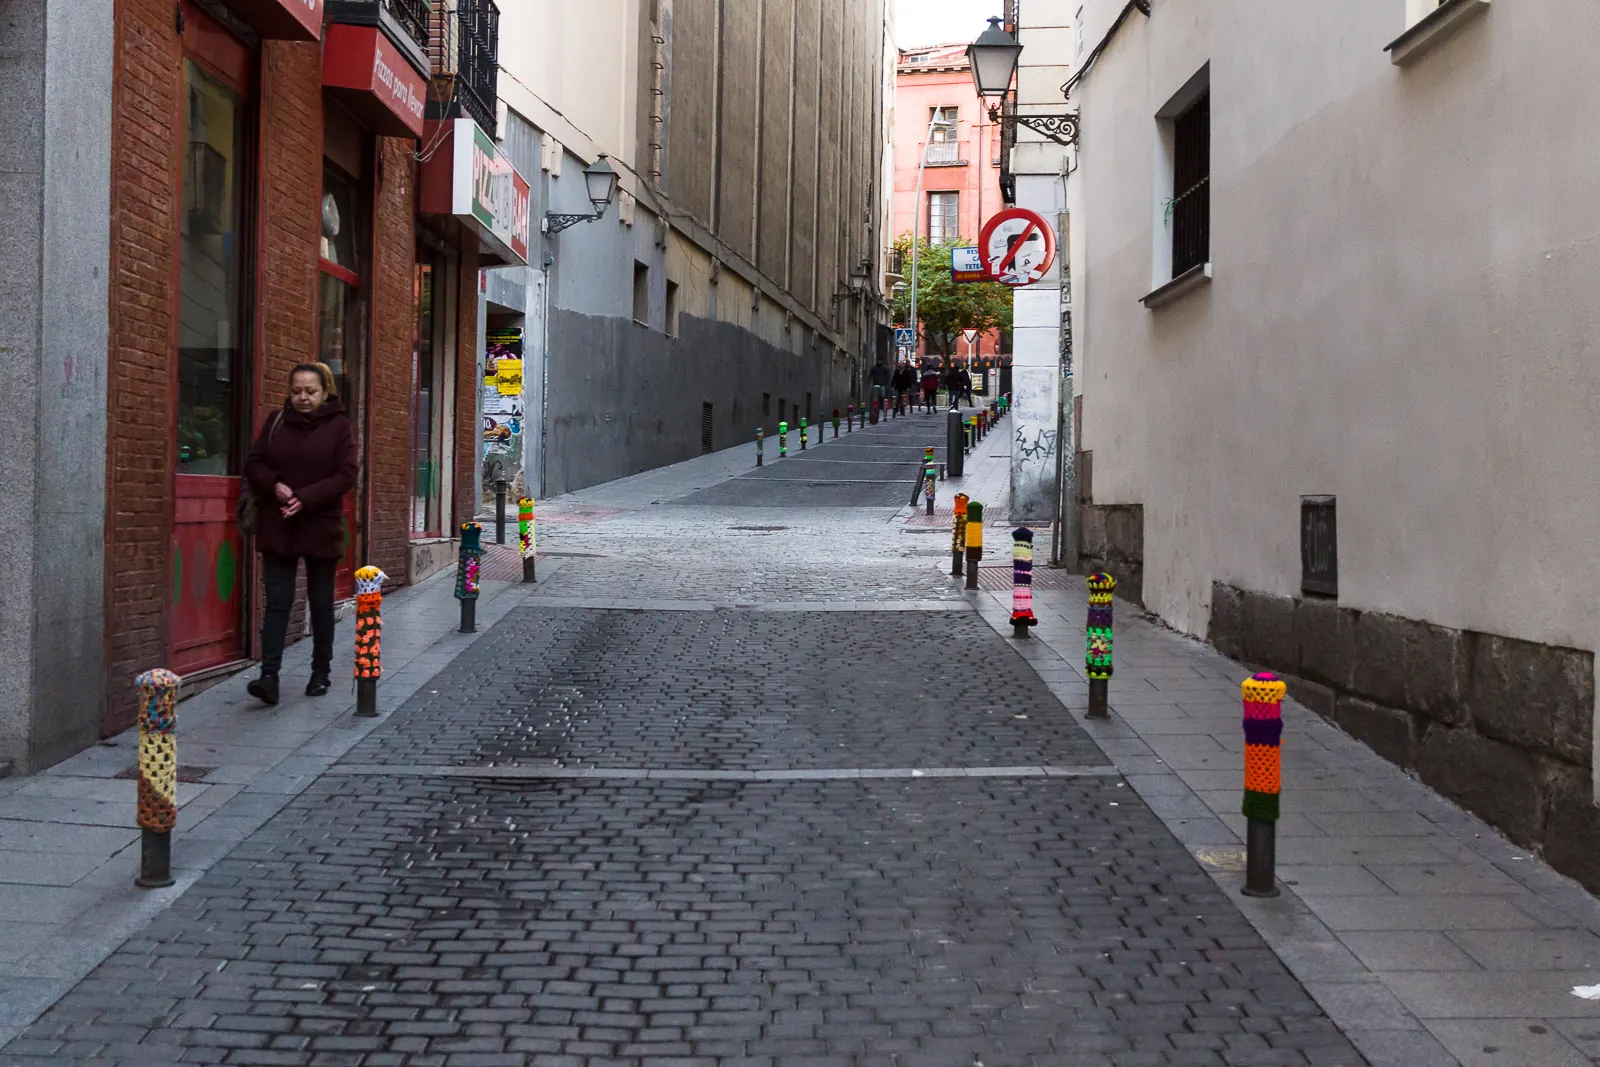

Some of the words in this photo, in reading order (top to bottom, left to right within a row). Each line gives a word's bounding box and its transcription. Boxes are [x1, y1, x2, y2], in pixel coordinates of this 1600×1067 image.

[374, 48, 394, 89] Pizzas
[392, 76, 408, 104] para
[407, 83, 424, 119] llevar
[511, 186, 528, 247] BAR
